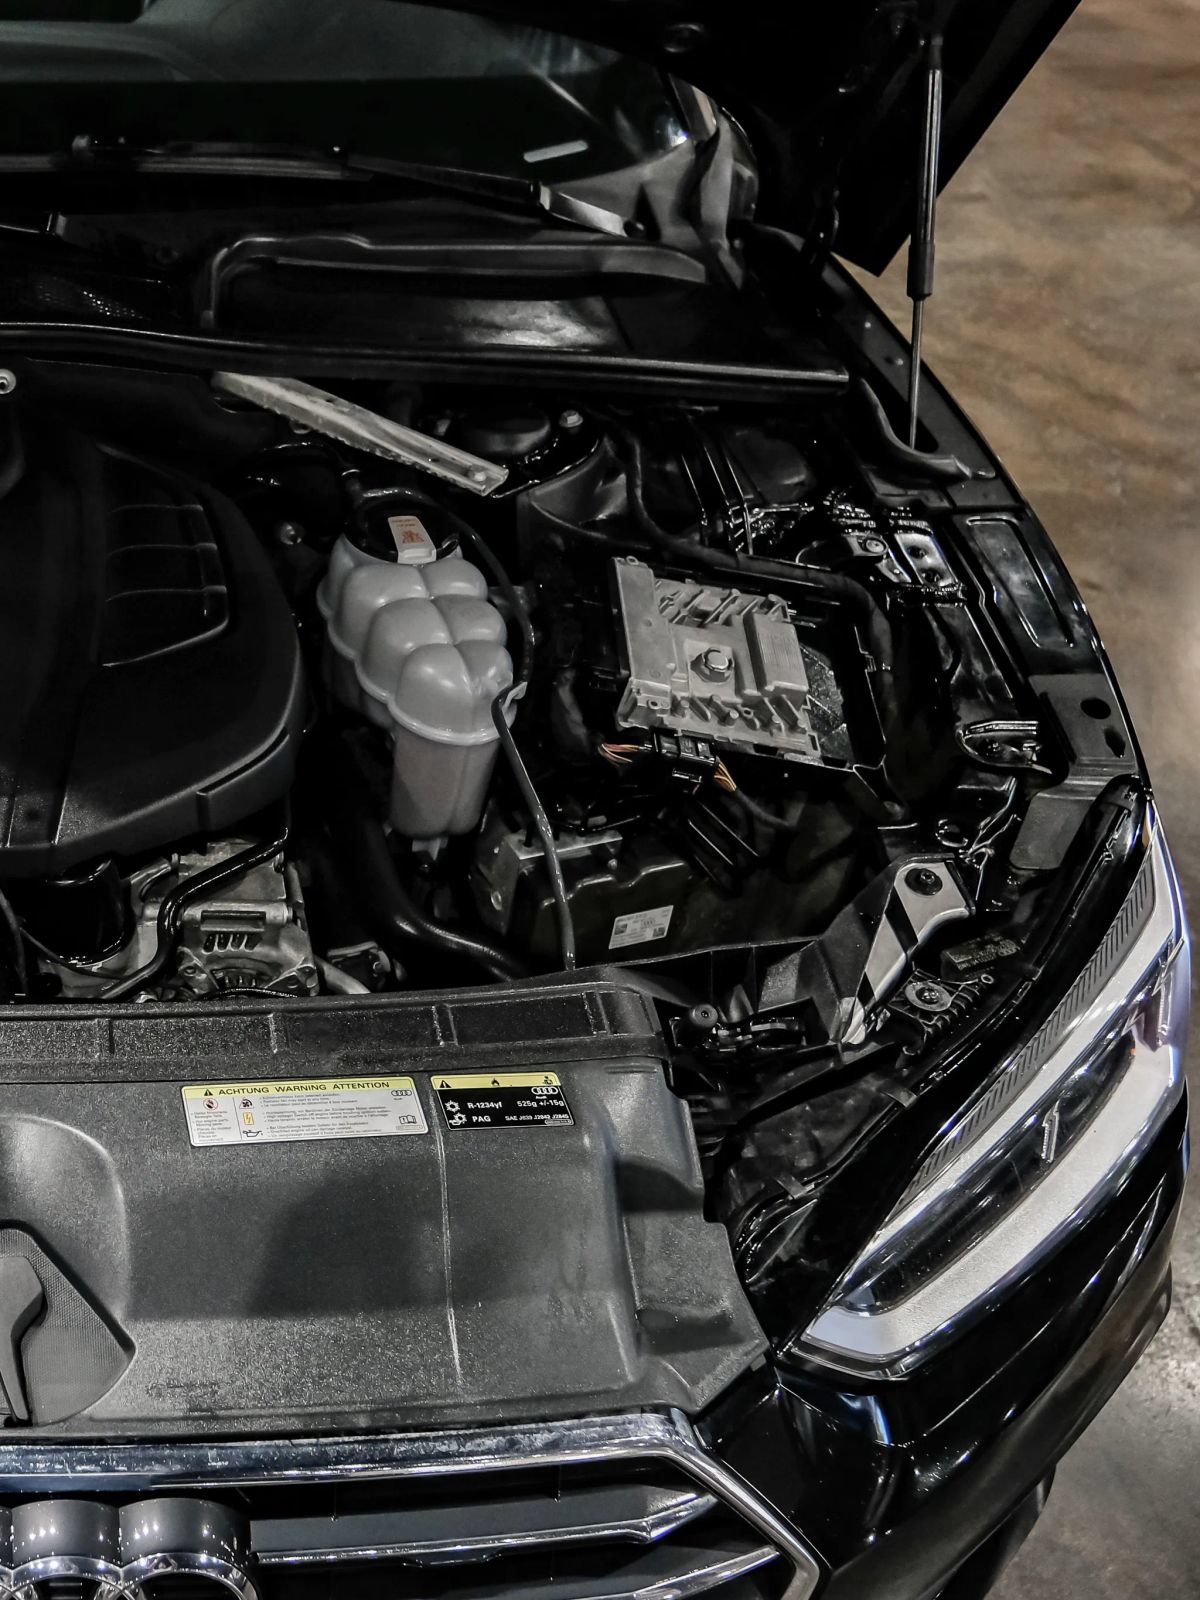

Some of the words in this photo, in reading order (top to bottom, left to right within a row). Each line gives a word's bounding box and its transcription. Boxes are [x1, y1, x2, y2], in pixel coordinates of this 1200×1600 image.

[218, 1087, 270, 1096] ACHTUNG
[274, 1084, 327, 1093] WARNING
[333, 1081, 390, 1090] ATTENTION
[467, 1101, 503, 1109] R-1234yf
[539, 1099, 565, 1107] +/-15g
